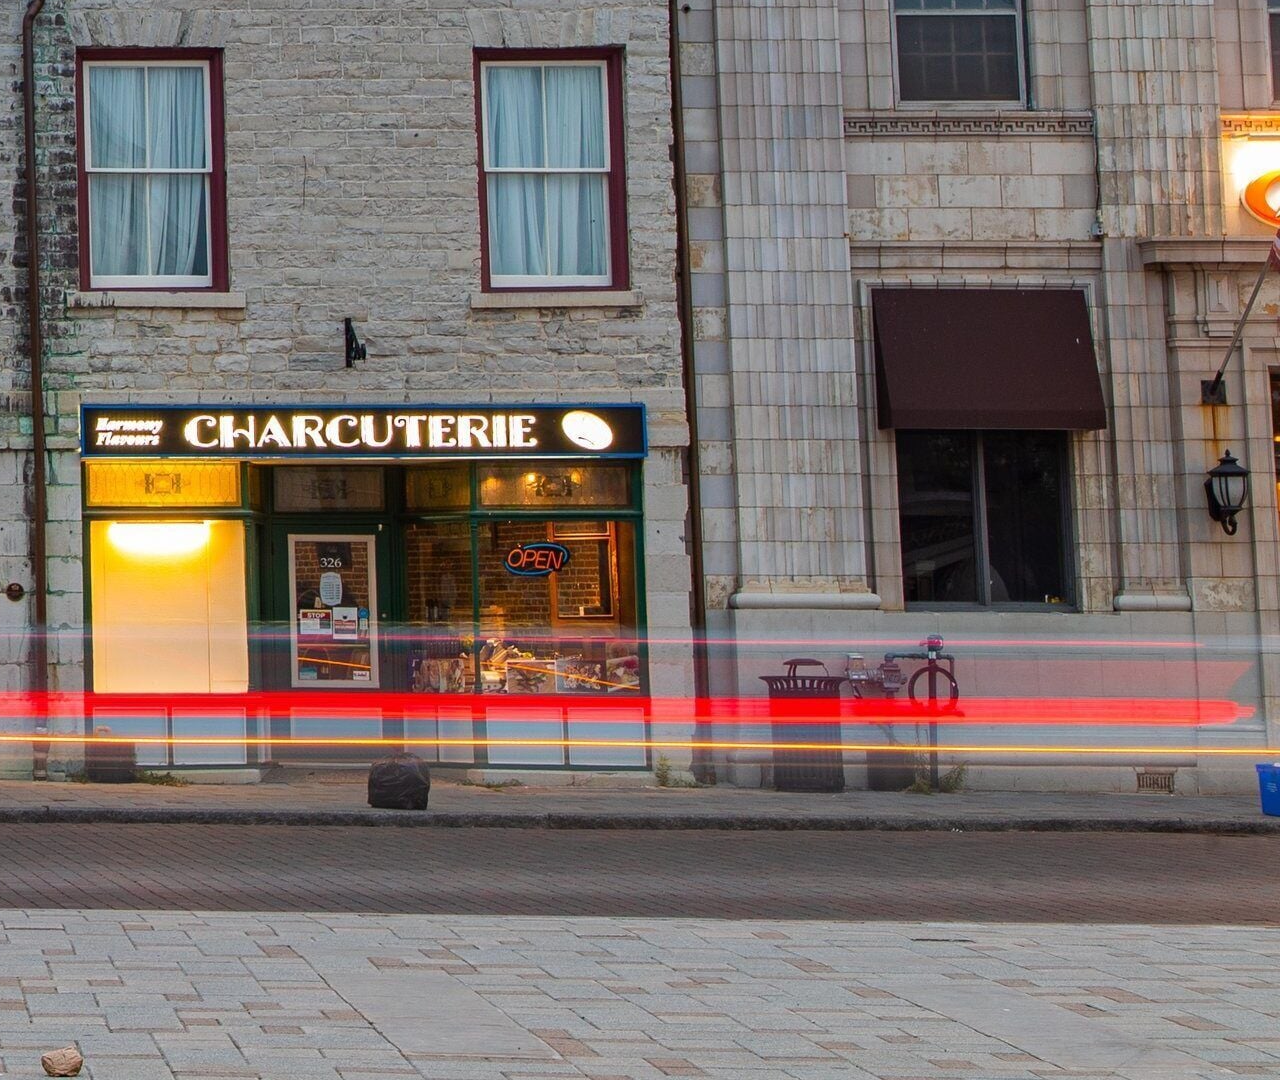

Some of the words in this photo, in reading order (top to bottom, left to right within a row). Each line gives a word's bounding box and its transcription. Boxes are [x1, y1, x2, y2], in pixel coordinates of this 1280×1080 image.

[95, 431, 160, 445] Flavours
[183, 414, 538, 449] CHARCUTERIE
[320, 557, 342, 568] 326
[507, 548, 563, 570] OPEN
